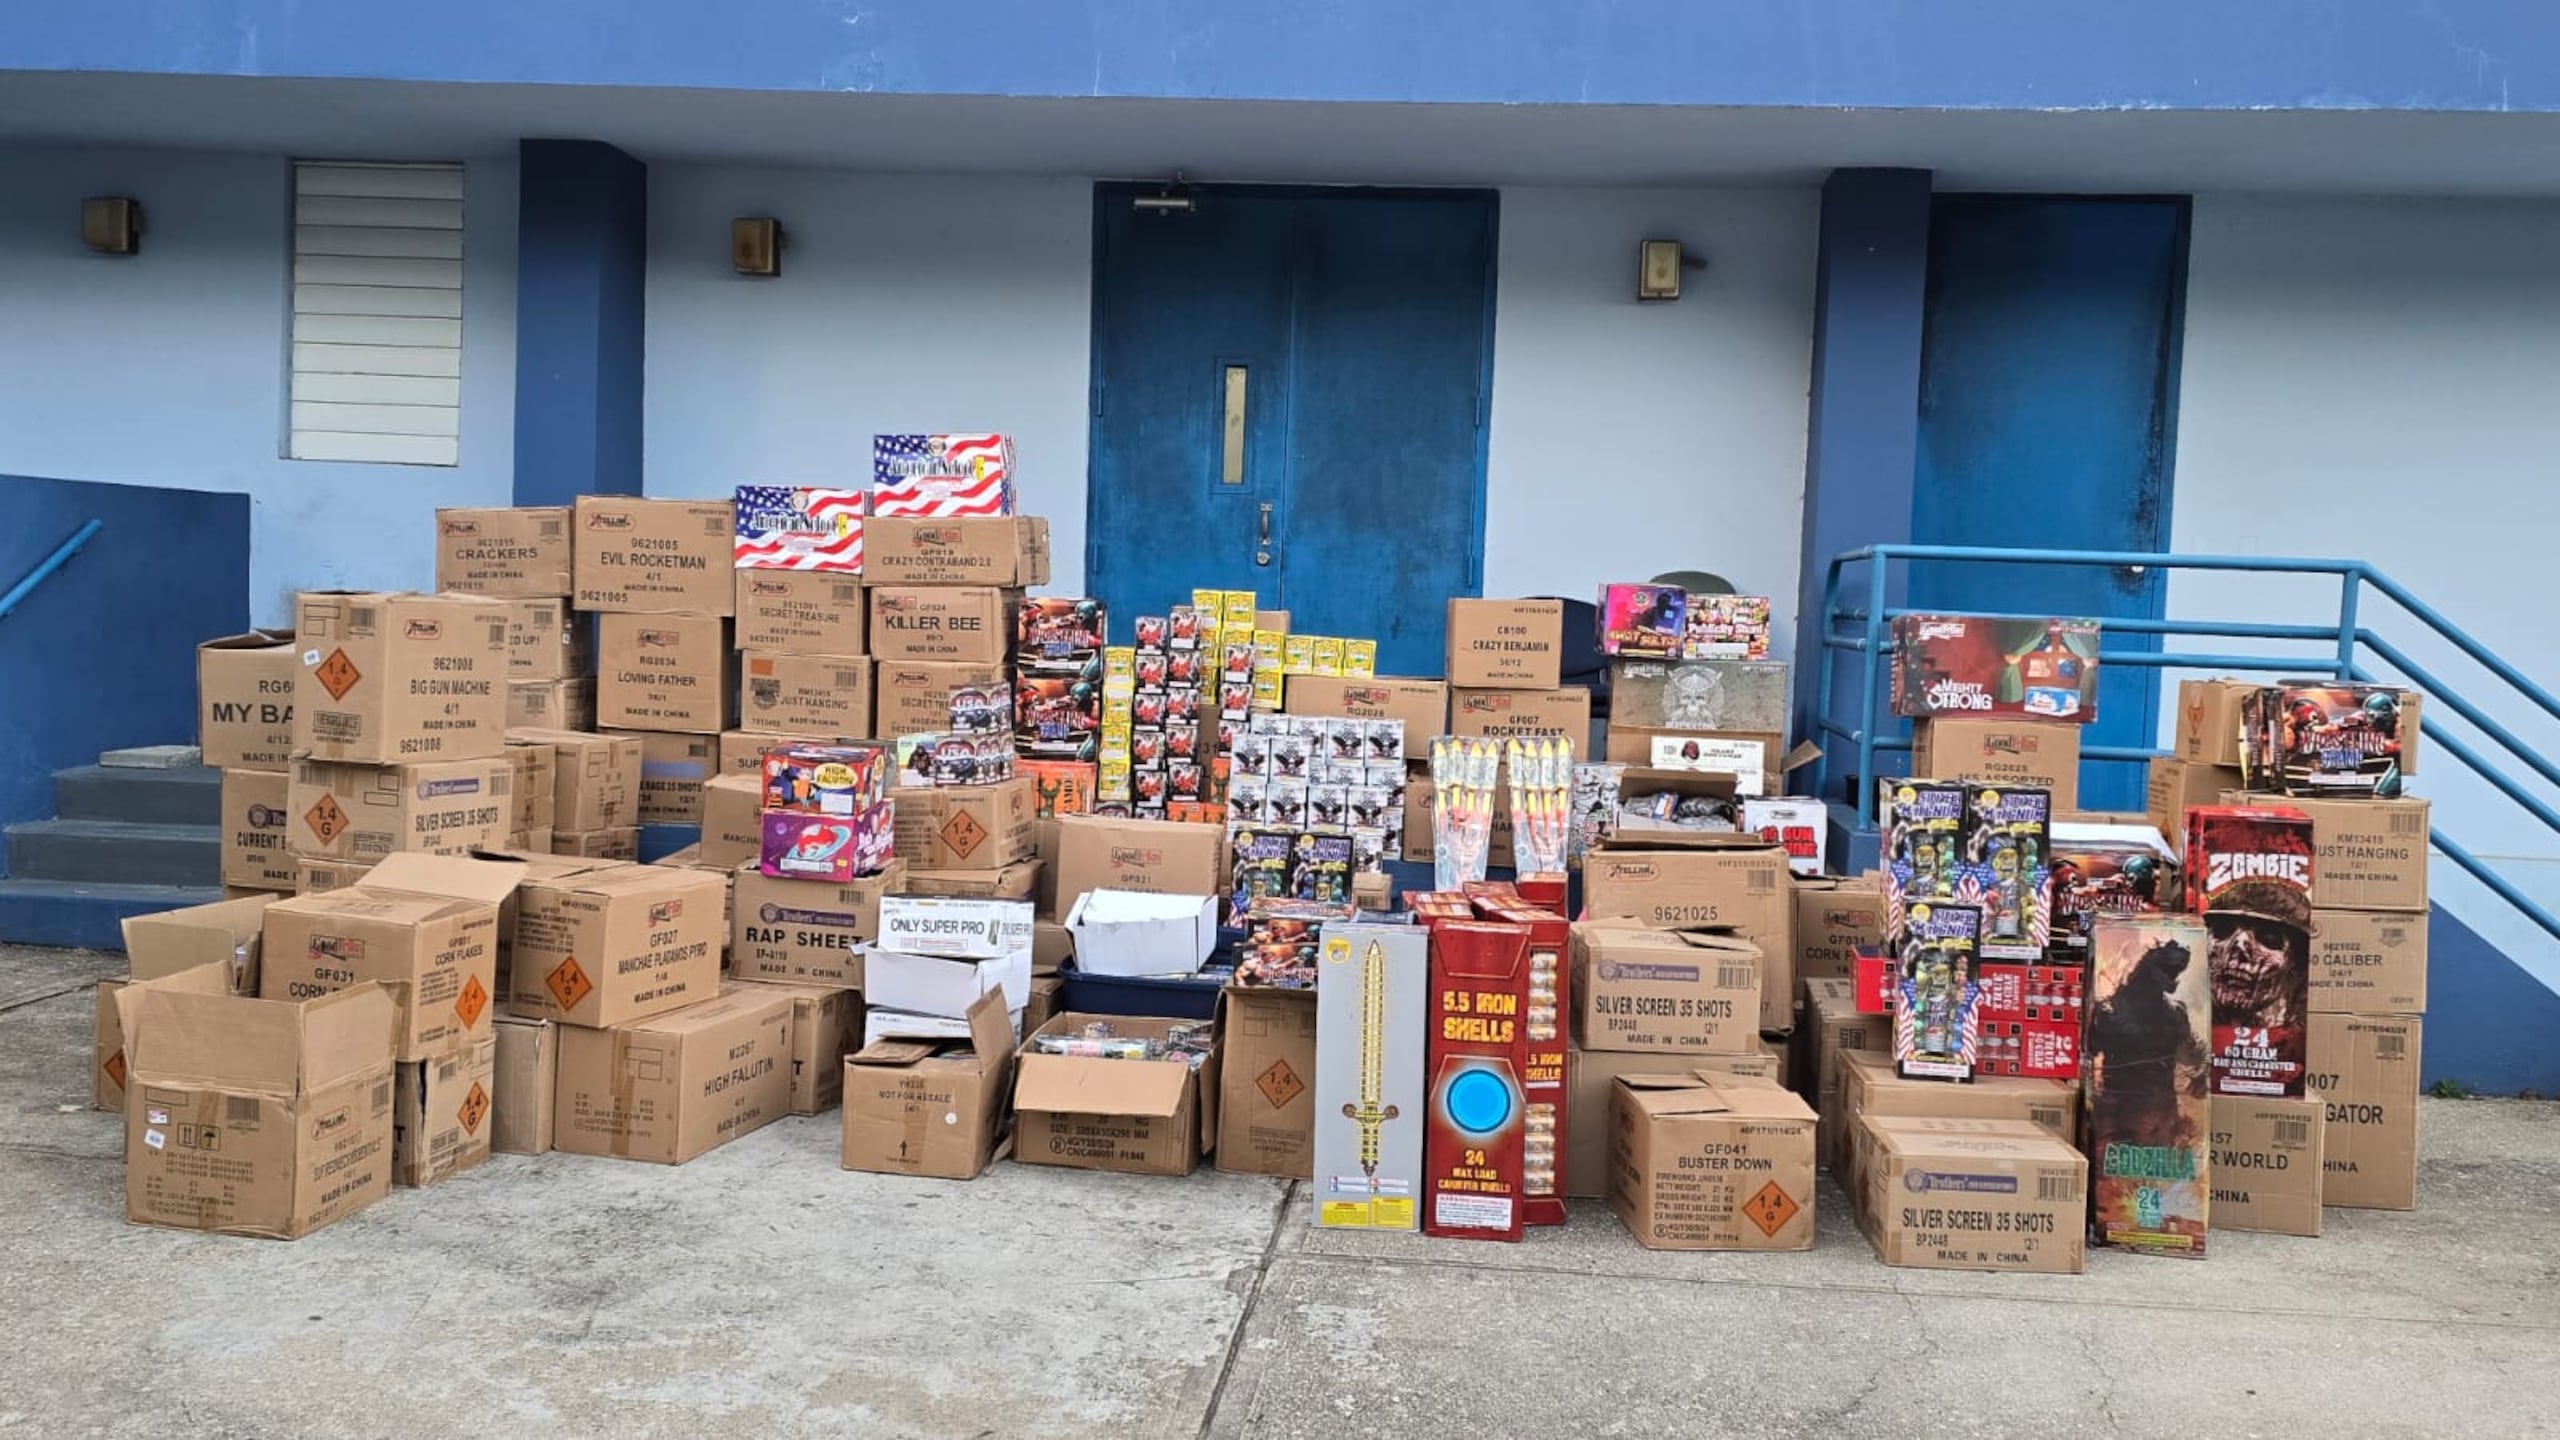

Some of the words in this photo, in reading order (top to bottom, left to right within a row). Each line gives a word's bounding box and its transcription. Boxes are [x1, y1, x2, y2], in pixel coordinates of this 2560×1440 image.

[631, 538, 678, 550] 9621005
[456, 548, 538, 560] CRACKERS
[601, 552, 626, 565] EVIL
[631, 553, 706, 570] ROCKETMAN
[882, 557, 913, 566] CRAZY
[915, 557, 977, 567] CONTRABAND
[580, 590, 628, 602] 9621005
[760, 608, 793, 618] SECRET
[795, 610, 840, 623] TREASURE
[885, 616, 940, 630] KILLER
[949, 617, 981, 630] BEE
[1497, 626, 1527, 636] CB100
[1473, 640, 1500, 651] CRAZY
[1503, 641, 1549, 652] BENJAMIN
[328, 660, 348, 675] 1.4
[618, 672, 655, 685] LOVING
[658, 674, 696, 687] FATHER
[410, 680, 428, 694] BIG
[430, 680, 450, 695] GUN
[452, 680, 491, 695] MACHINE
[781, 697, 804, 706] JUST
[805, 698, 848, 710] HANGING
[901, 697, 932, 709] SECRET
[956, 699, 984, 709] USA
[1928, 684, 1992, 710] STRONG
[213, 703, 252, 722] MY
[444, 704, 459, 715] 4/1
[1483, 726, 1530, 736] ROCKET
[1534, 728, 1564, 737] FAST
[242, 752, 274, 762] MADE
[276, 753, 289, 762] IN
[941, 747, 969, 758] USA
[318, 806, 336, 821] 1.4
[415, 812, 439, 831] SILVER
[441, 810, 465, 829] SCREEN
[477, 806, 498, 824] SHOTS
[321, 822, 331, 836] G
[953, 822, 974, 834] 1.4
[1783, 826, 1815, 842] GUN
[237, 831, 277, 847] CURRENT
[959, 837, 968, 846] G
[2346, 847, 2409, 860] HANGING
[263, 870, 289, 880] MADE
[2325, 872, 2352, 880] MADE
[2354, 873, 2366, 881] IN
[2367, 873, 2398, 882] CHINA
[1655, 907, 1718, 921] 9621025
[891, 918, 920, 933] ONLY
[922, 919, 958, 934] SUPER
[961, 921, 985, 935] PRO
[651, 930, 678, 947] GF027
[746, 928, 785, 944] RAP
[797, 931, 862, 949] SHEET
[435, 951, 455, 966] CORN
[457, 945, 484, 961] FLAKES
[653, 947, 687, 967] PLATANOS
[1806, 947, 1840, 961] CORN
[2323, 954, 2382, 967] CALIBER
[559, 967, 578, 984] 1.4
[760, 963, 786, 974] MADE
[795, 965, 805, 975] IN
[812, 966, 842, 978] CHINA
[289, 983, 327, 998] CORN
[1443, 991, 1470, 1013] 5.5
[1476, 992, 1516, 1015] IRON
[1596, 996, 1632, 1015] SILVER
[1636, 997, 1676, 1017] SCREEN
[1680, 999, 1693, 1017] 35
[1697, 1000, 1732, 1018] SHOTS
[1443, 1018, 1515, 1043] SHELLS
[2233, 1027, 2270, 1048] 24
[1628, 1034, 1656, 1045] MADE
[1662, 1035, 1672, 1045] IN
[1680, 1035, 1708, 1046] CHINA
[2225, 1046, 2240, 1058] 60
[2243, 1047, 2278, 1060] GRAM
[704, 1074, 730, 1097] HIGH
[731, 1057, 774, 1086] FALUTIN
[1270, 1071, 1290, 1086] 1.4
[2230, 1068, 2272, 1079] SHELLS
[468, 1111, 476, 1126] G
[2326, 1103, 2383, 1125] GATOR
[1704, 1143, 1747, 1155] GF041
[1465, 1150, 1485, 1166] 24
[1678, 1158, 1729, 1170] BUSTER
[1734, 1158, 1773, 1171] DOWN
[2222, 1152, 2288, 1170] WORLD
[1453, 1167, 1472, 1178] MAX
[1475, 1168, 1497, 1180] LOAD
[2322, 1160, 2358, 1173] HINA
[1760, 1195, 1782, 1208] 1.4
[2137, 1187, 2160, 1210] 24
[1765, 1211, 1774, 1221] G
[1903, 1208, 1943, 1230] SILVER
[1947, 1210, 1992, 1232] SCREEN
[1996, 1212, 2010, 1232] 35
[2014, 1212, 2054, 1233] SHOTS
[1937, 1250, 1968, 1262] MADE
[1977, 1251, 1988, 1262] IN
[1996, 1251, 2028, 1263] CHINA
